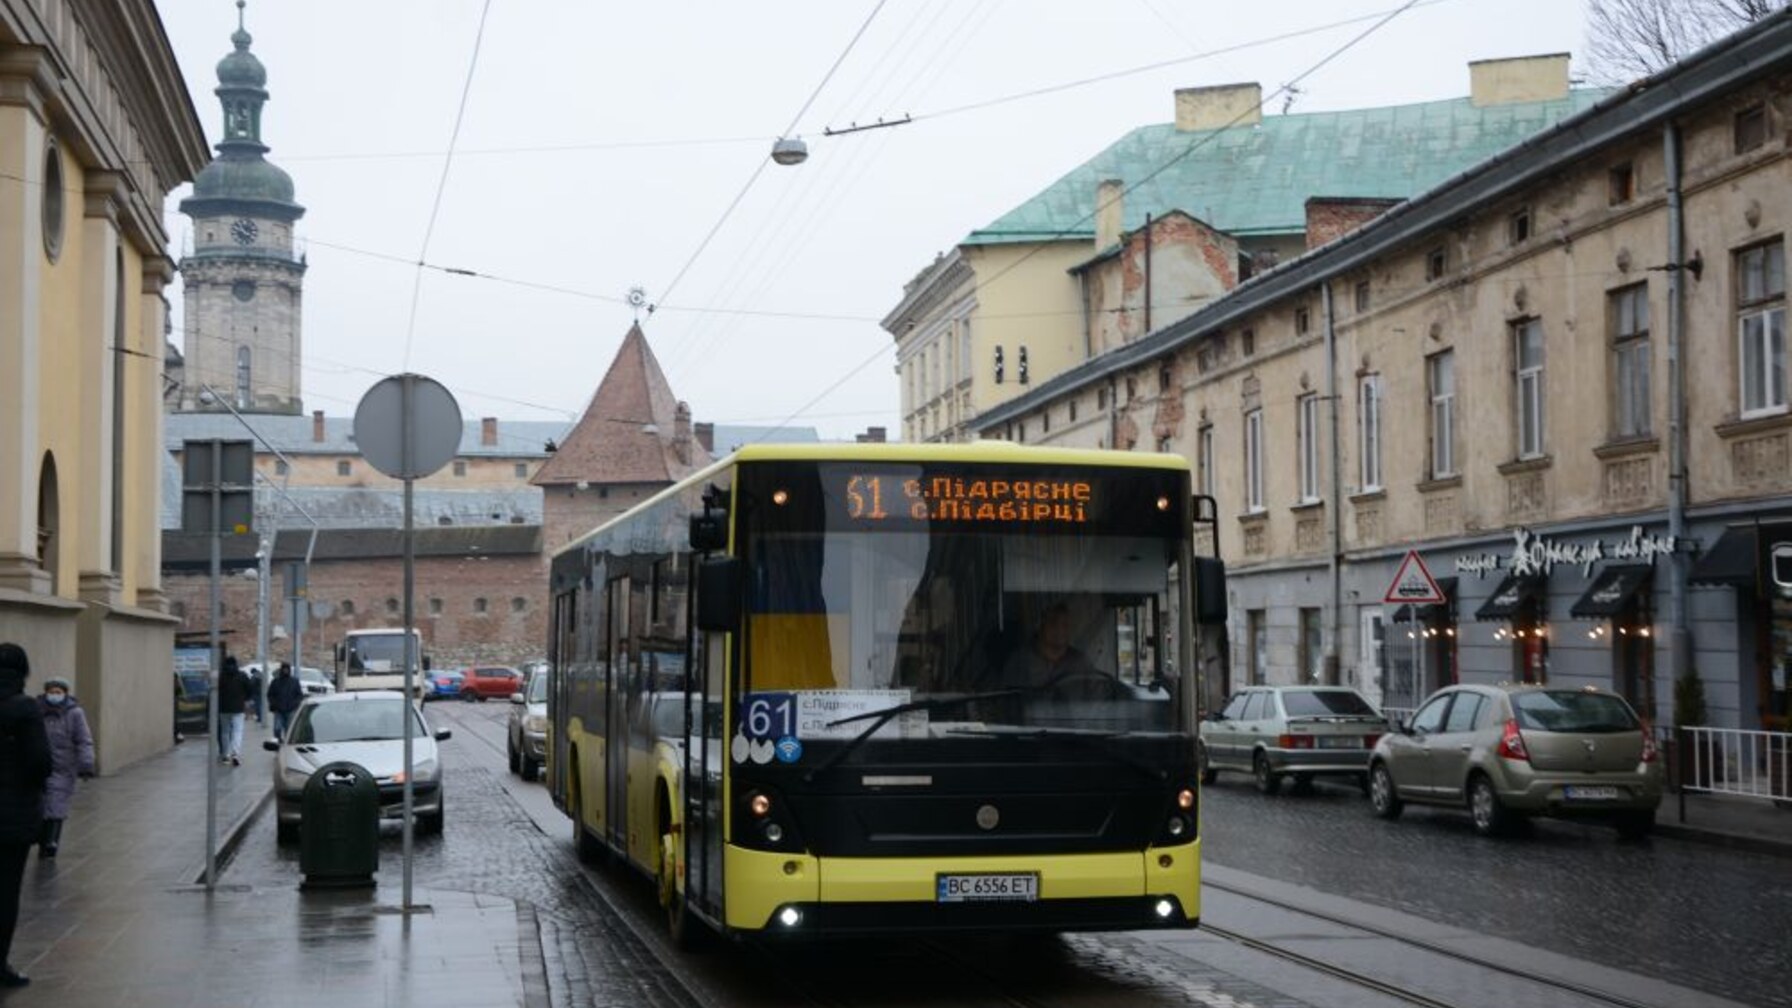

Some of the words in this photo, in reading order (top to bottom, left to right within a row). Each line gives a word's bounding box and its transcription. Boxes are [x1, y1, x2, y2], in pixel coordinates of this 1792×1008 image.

[847, 475, 888, 519] 61
[911, 499, 1086, 521] с.Підбірці
[749, 700, 791, 736] 61
[949, 879, 970, 894] BC
[974, 878, 1008, 894] 6556
[1012, 878, 1033, 894] ET
